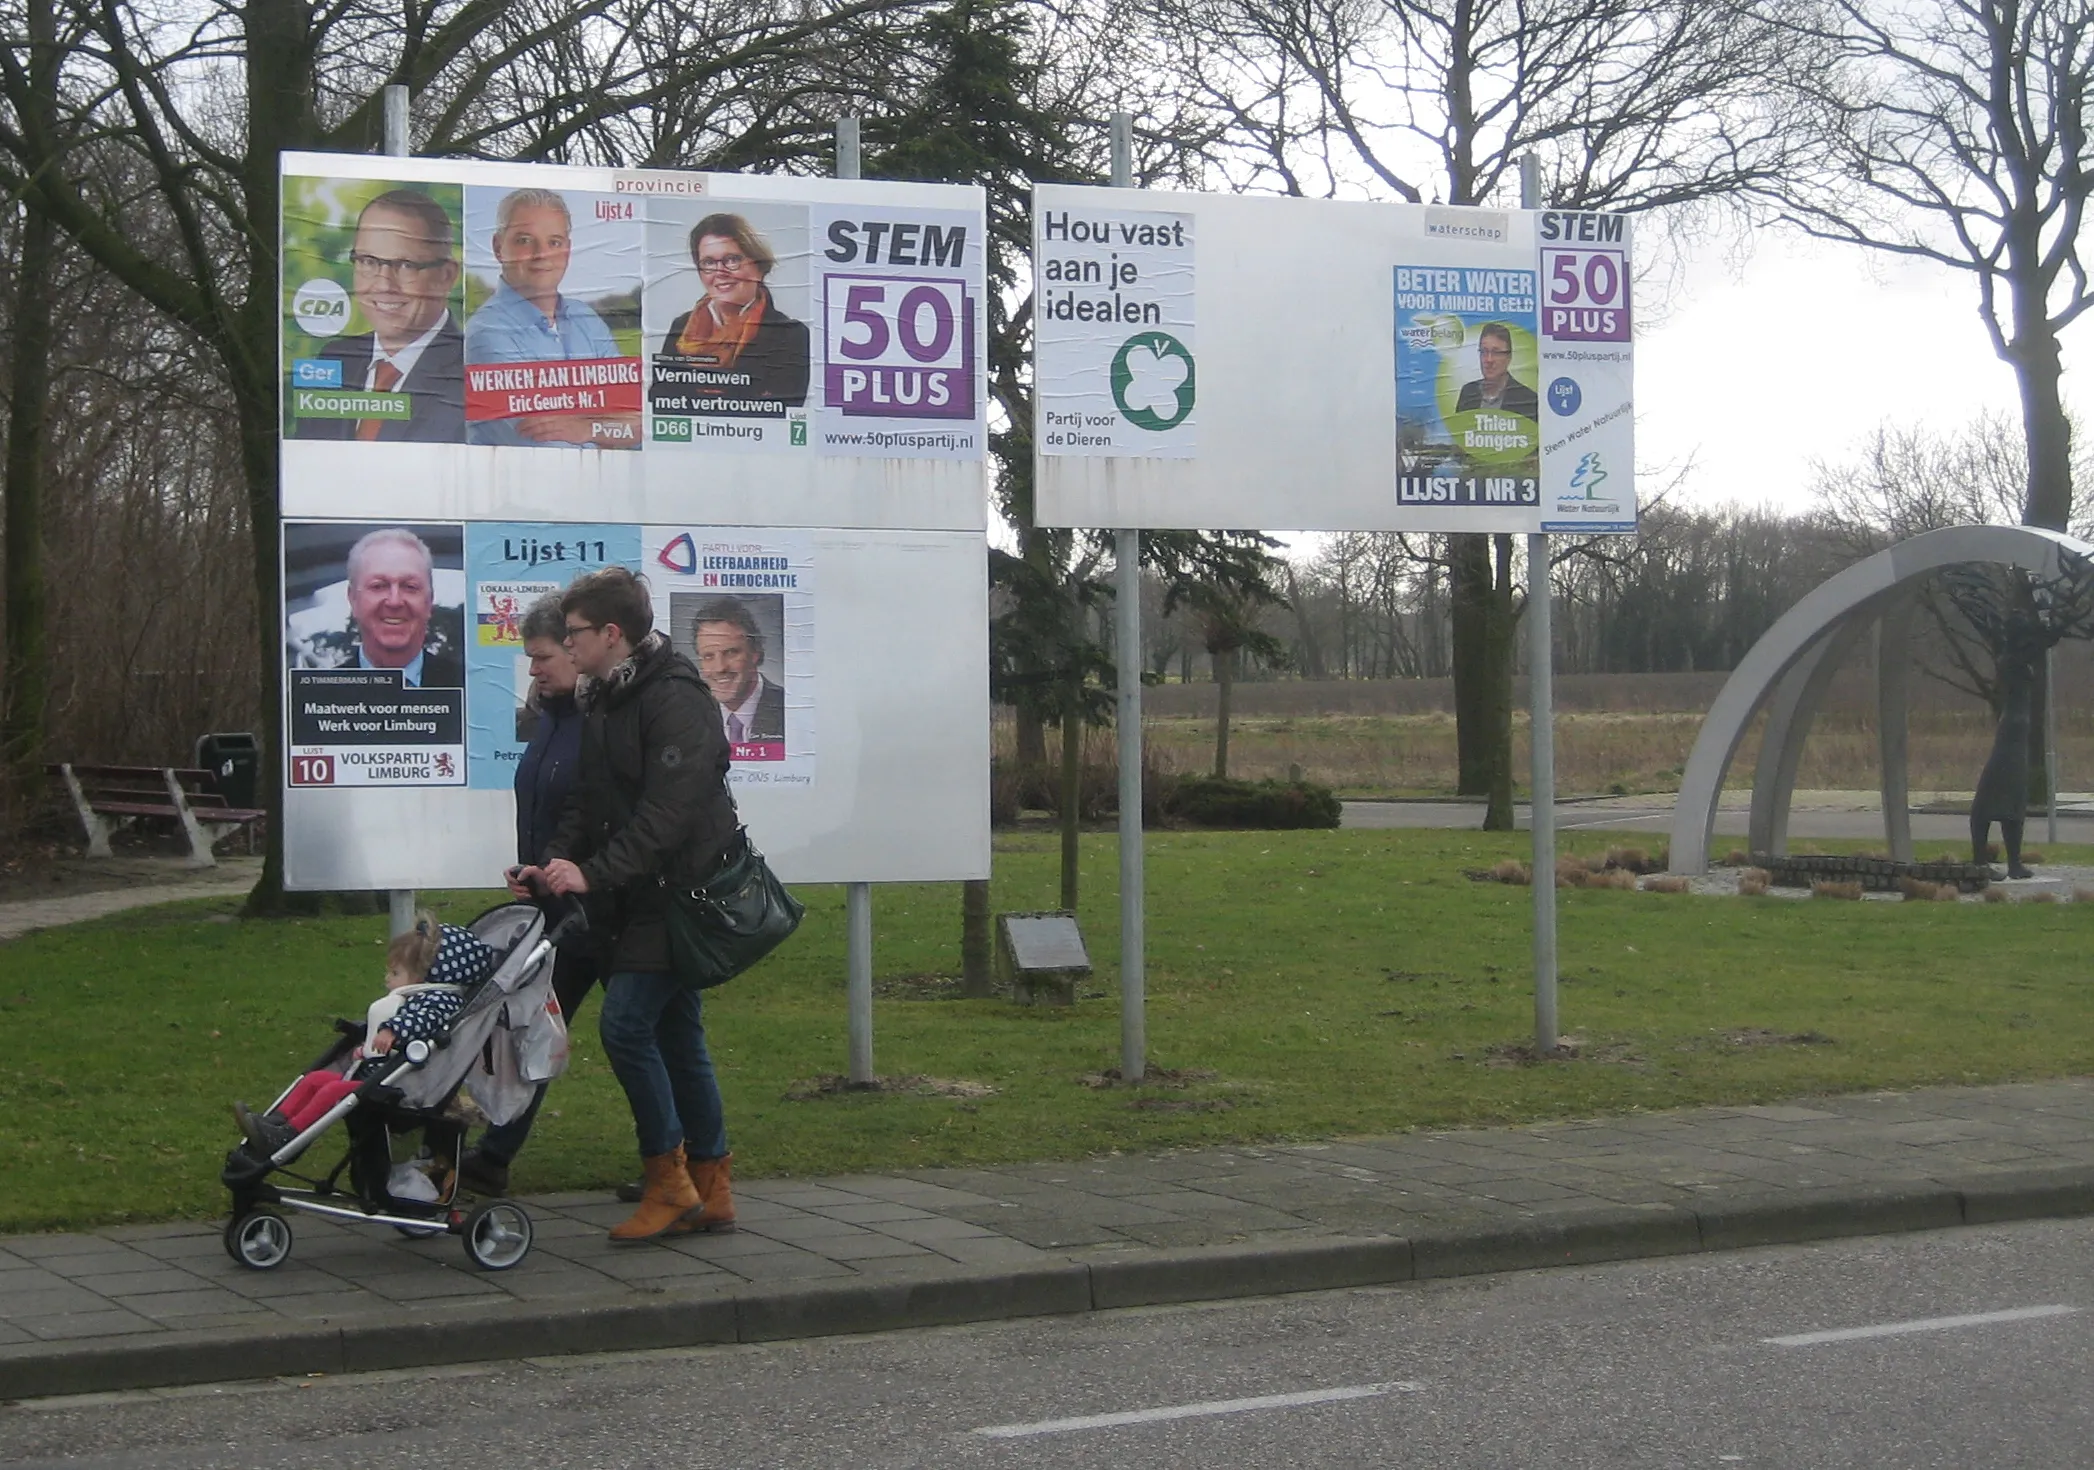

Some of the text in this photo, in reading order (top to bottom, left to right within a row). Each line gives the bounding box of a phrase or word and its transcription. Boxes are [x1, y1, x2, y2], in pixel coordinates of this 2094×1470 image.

[616, 179, 702, 193] provincie
[595, 201, 633, 221] Lijst 4
[1046, 211, 1184, 246] Hou vast
[1429, 223, 1501, 239] waterschap
[1540, 212, 1623, 243] STEM
[824, 220, 966, 267] STEM
[1046, 253, 1138, 290] aan je
[1550, 255, 1617, 305] 50
[1398, 269, 1532, 294] BETER WATER
[299, 299, 344, 316] CDA
[1046, 290, 1161, 324] idealen
[1398, 294, 1534, 312] VOOR MINDER GELD
[840, 285, 954, 362] 50
[1553, 311, 1616, 333] PLUS
[300, 364, 333, 381] Ger
[470, 363, 638, 391] WERKEN AAN LIMBURG
[655, 368, 750, 385] Vernieuwen
[843, 370, 949, 404] PLUS
[1555, 385, 1573, 396] Lijst
[300, 395, 405, 413] Koopmans
[509, 390, 604, 412] Eric Geurts Nr. 1
[655, 396, 783, 413] met vertrouwen
[1561, 399, 1567, 408] 4
[1046, 412, 1115, 427] Partij voor
[1475, 414, 1517, 432] Thieu
[655, 421, 763, 441] D66 Limburg
[794, 425, 803, 438] 7
[1046, 432, 1111, 446] de Dieren
[1544, 438, 1566, 455] Stem
[1567, 425, 1592, 441] Water
[825, 431, 973, 450] www.50pluspartij.nl
[1465, 431, 1528, 450] Bongers
[1401, 478, 1535, 501] LIJST 1 NR 3
[504, 539, 604, 566] Lijst 11
[703, 556, 788, 570] LEEFBAARHEID
[704, 574, 797, 587] EN DEMOCRATIE
[305, 703, 449, 714] Maatwerk voor mensen
[318, 720, 436, 733] Werk voor Limburg
[736, 747, 766, 756] Nr. 1
[300, 760, 328, 781] 10
[368, 767, 430, 778] LIMBURG
[774, 774, 810, 784] Limburg
